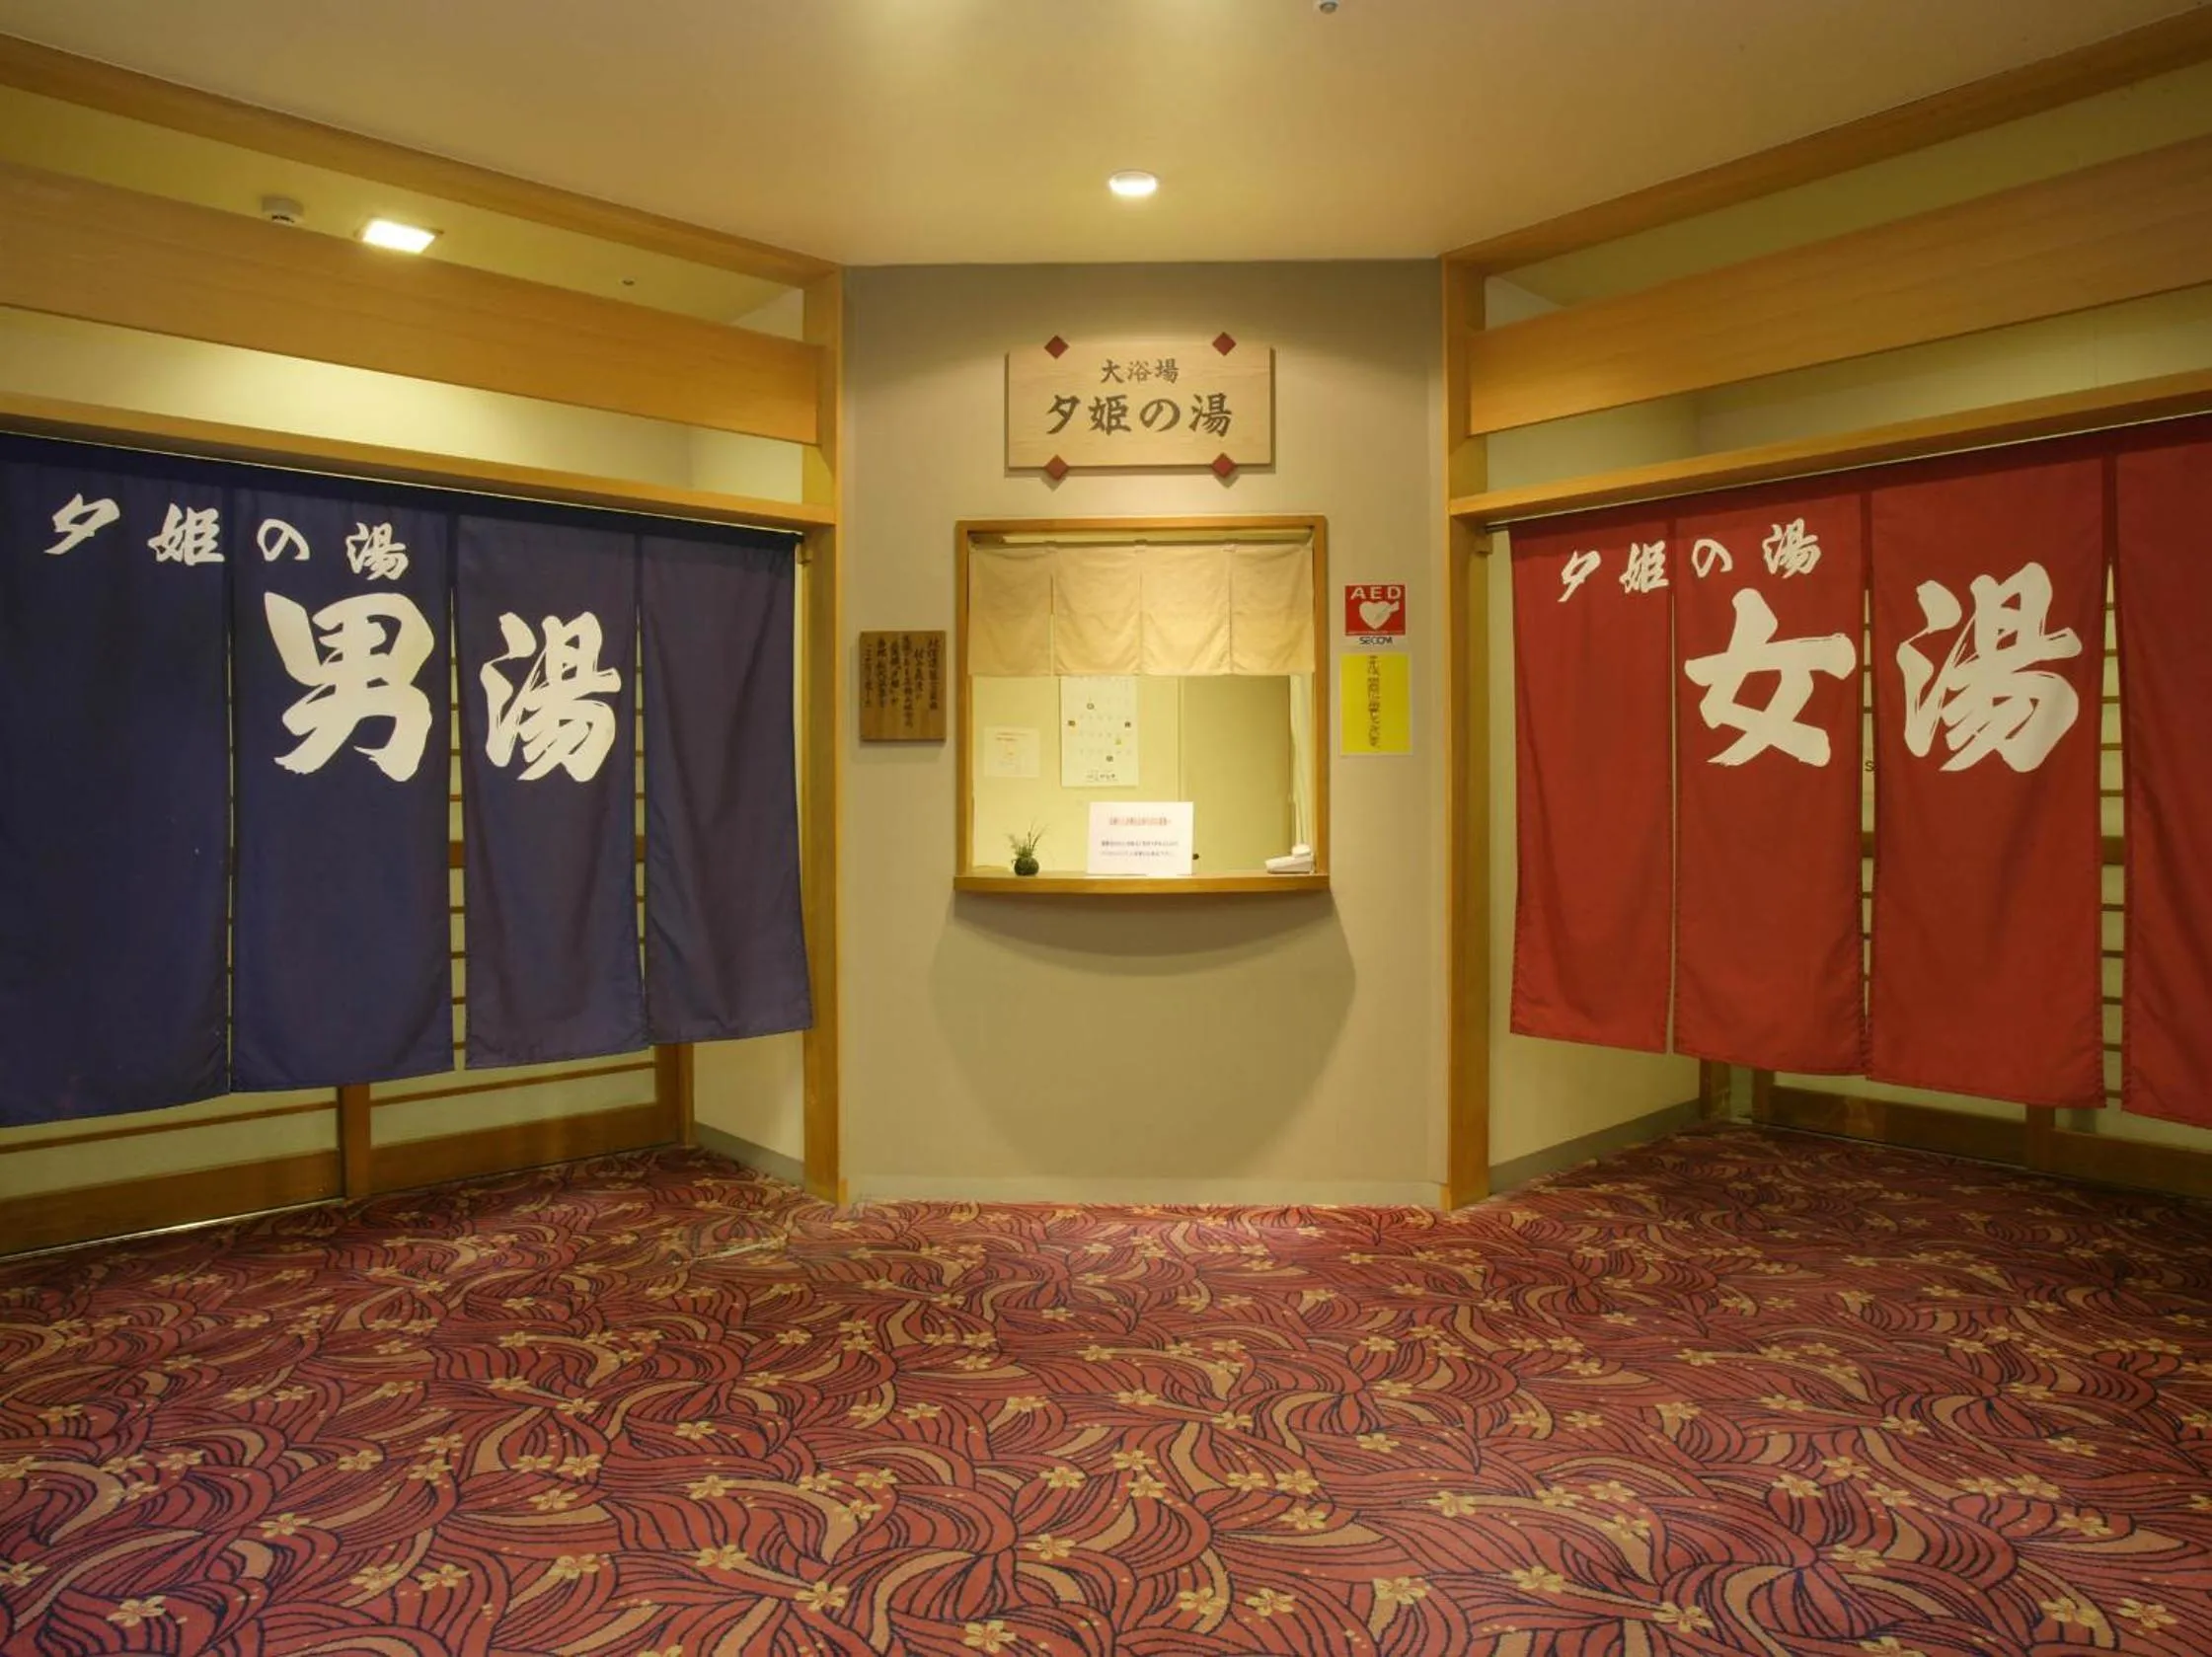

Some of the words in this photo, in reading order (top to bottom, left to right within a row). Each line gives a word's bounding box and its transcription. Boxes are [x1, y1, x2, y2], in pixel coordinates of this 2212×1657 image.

[1100, 358, 1180, 384] 大浴場
[1046, 393, 1233, 437] 夕姫の湯
[44, 492, 409, 580] 夕姫の湯
[1558, 518, 1822, 603] 夕姫の湯
[1350, 586, 1401, 600] AED
[264, 591, 622, 782] 男湯
[1684, 562, 2083, 773] 女湯
